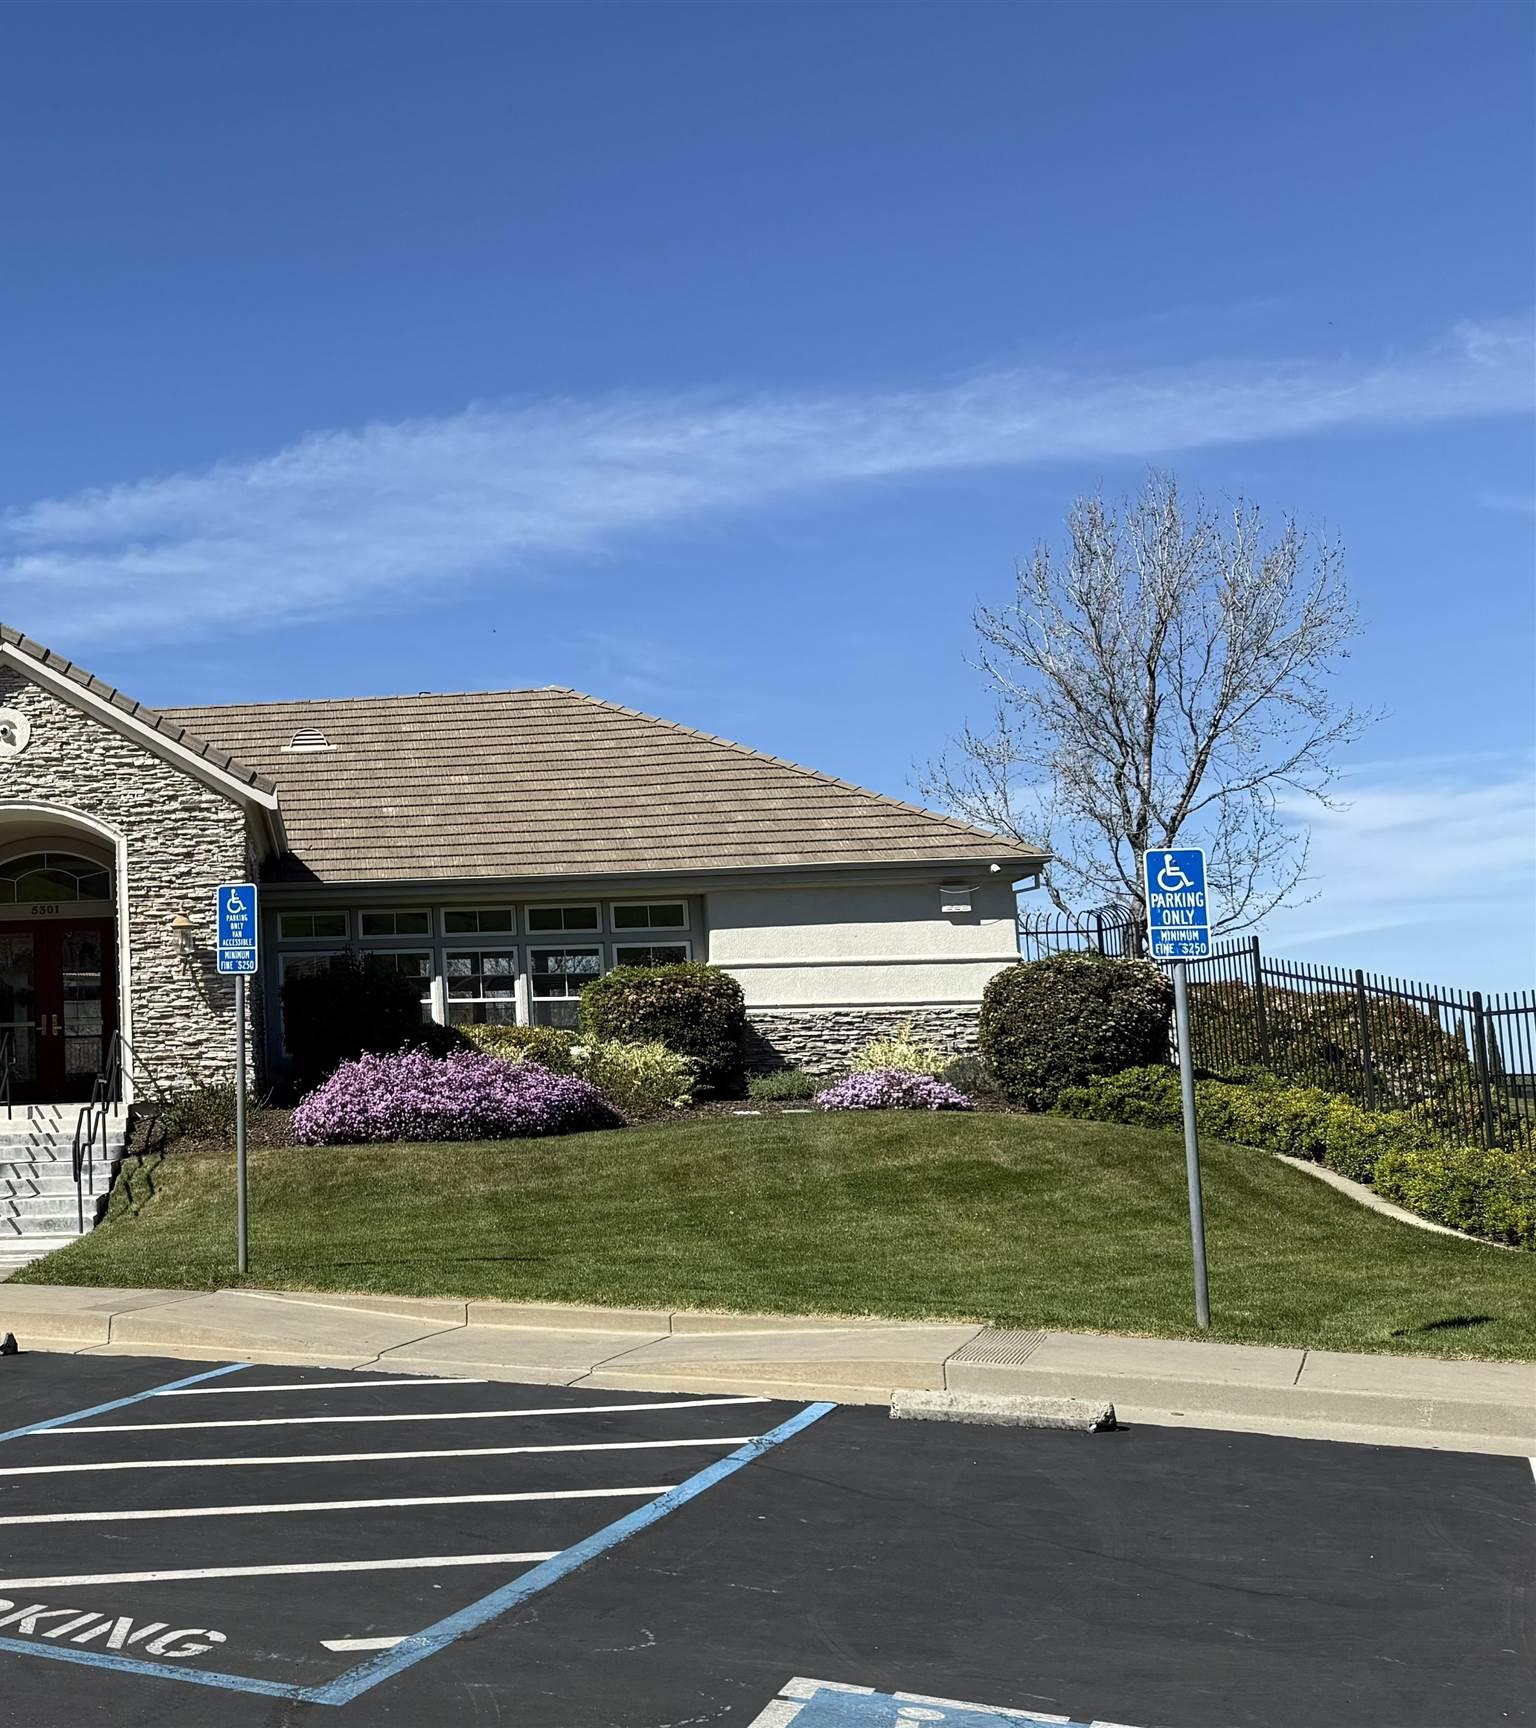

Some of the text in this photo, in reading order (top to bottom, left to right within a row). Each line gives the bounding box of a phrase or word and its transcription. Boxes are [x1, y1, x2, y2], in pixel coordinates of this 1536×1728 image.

[1151, 892, 1204, 908] PARKING
[226, 914, 248, 922] PARKING
[1163, 909, 1194, 925] ONLY
[230, 922, 243, 930] ONLY
[232, 930, 242, 938] VAN
[1161, 930, 1199, 941] MINIMUM
[223, 938, 252, 946] ACCESSIBLE
[1155, 942, 1206, 954] FINE $250
[225, 951, 250, 959] MINIMUM
[221, 960, 254, 970] FINE $250
